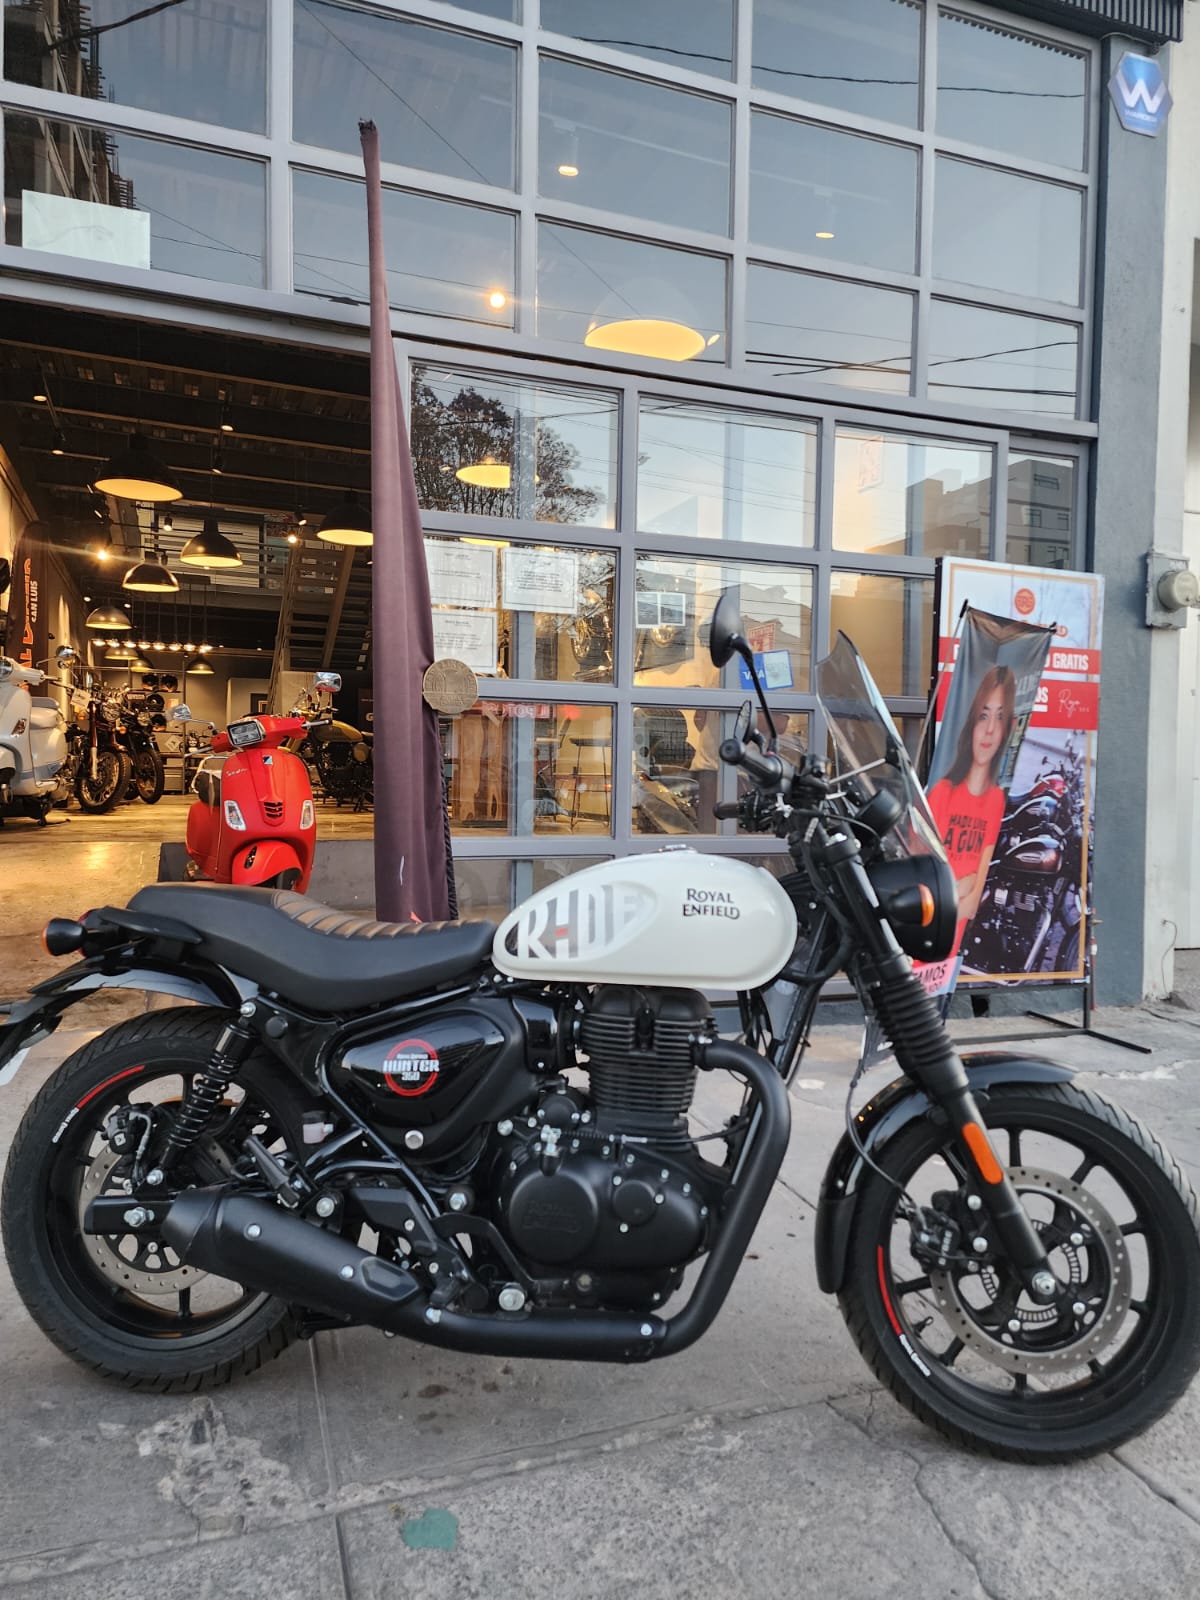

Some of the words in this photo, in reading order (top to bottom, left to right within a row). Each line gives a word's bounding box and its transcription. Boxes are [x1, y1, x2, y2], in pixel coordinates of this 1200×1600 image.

[1052, 652, 1089, 671] GRATIS
[742, 669, 765, 681] VA
[957, 829, 985, 853] GUN
[686, 887, 735, 904] ROYAL
[682, 903, 741, 920] ENFIELD
[383, 1059, 440, 1073] HUNTER
[401, 1071, 420, 1081] 350
